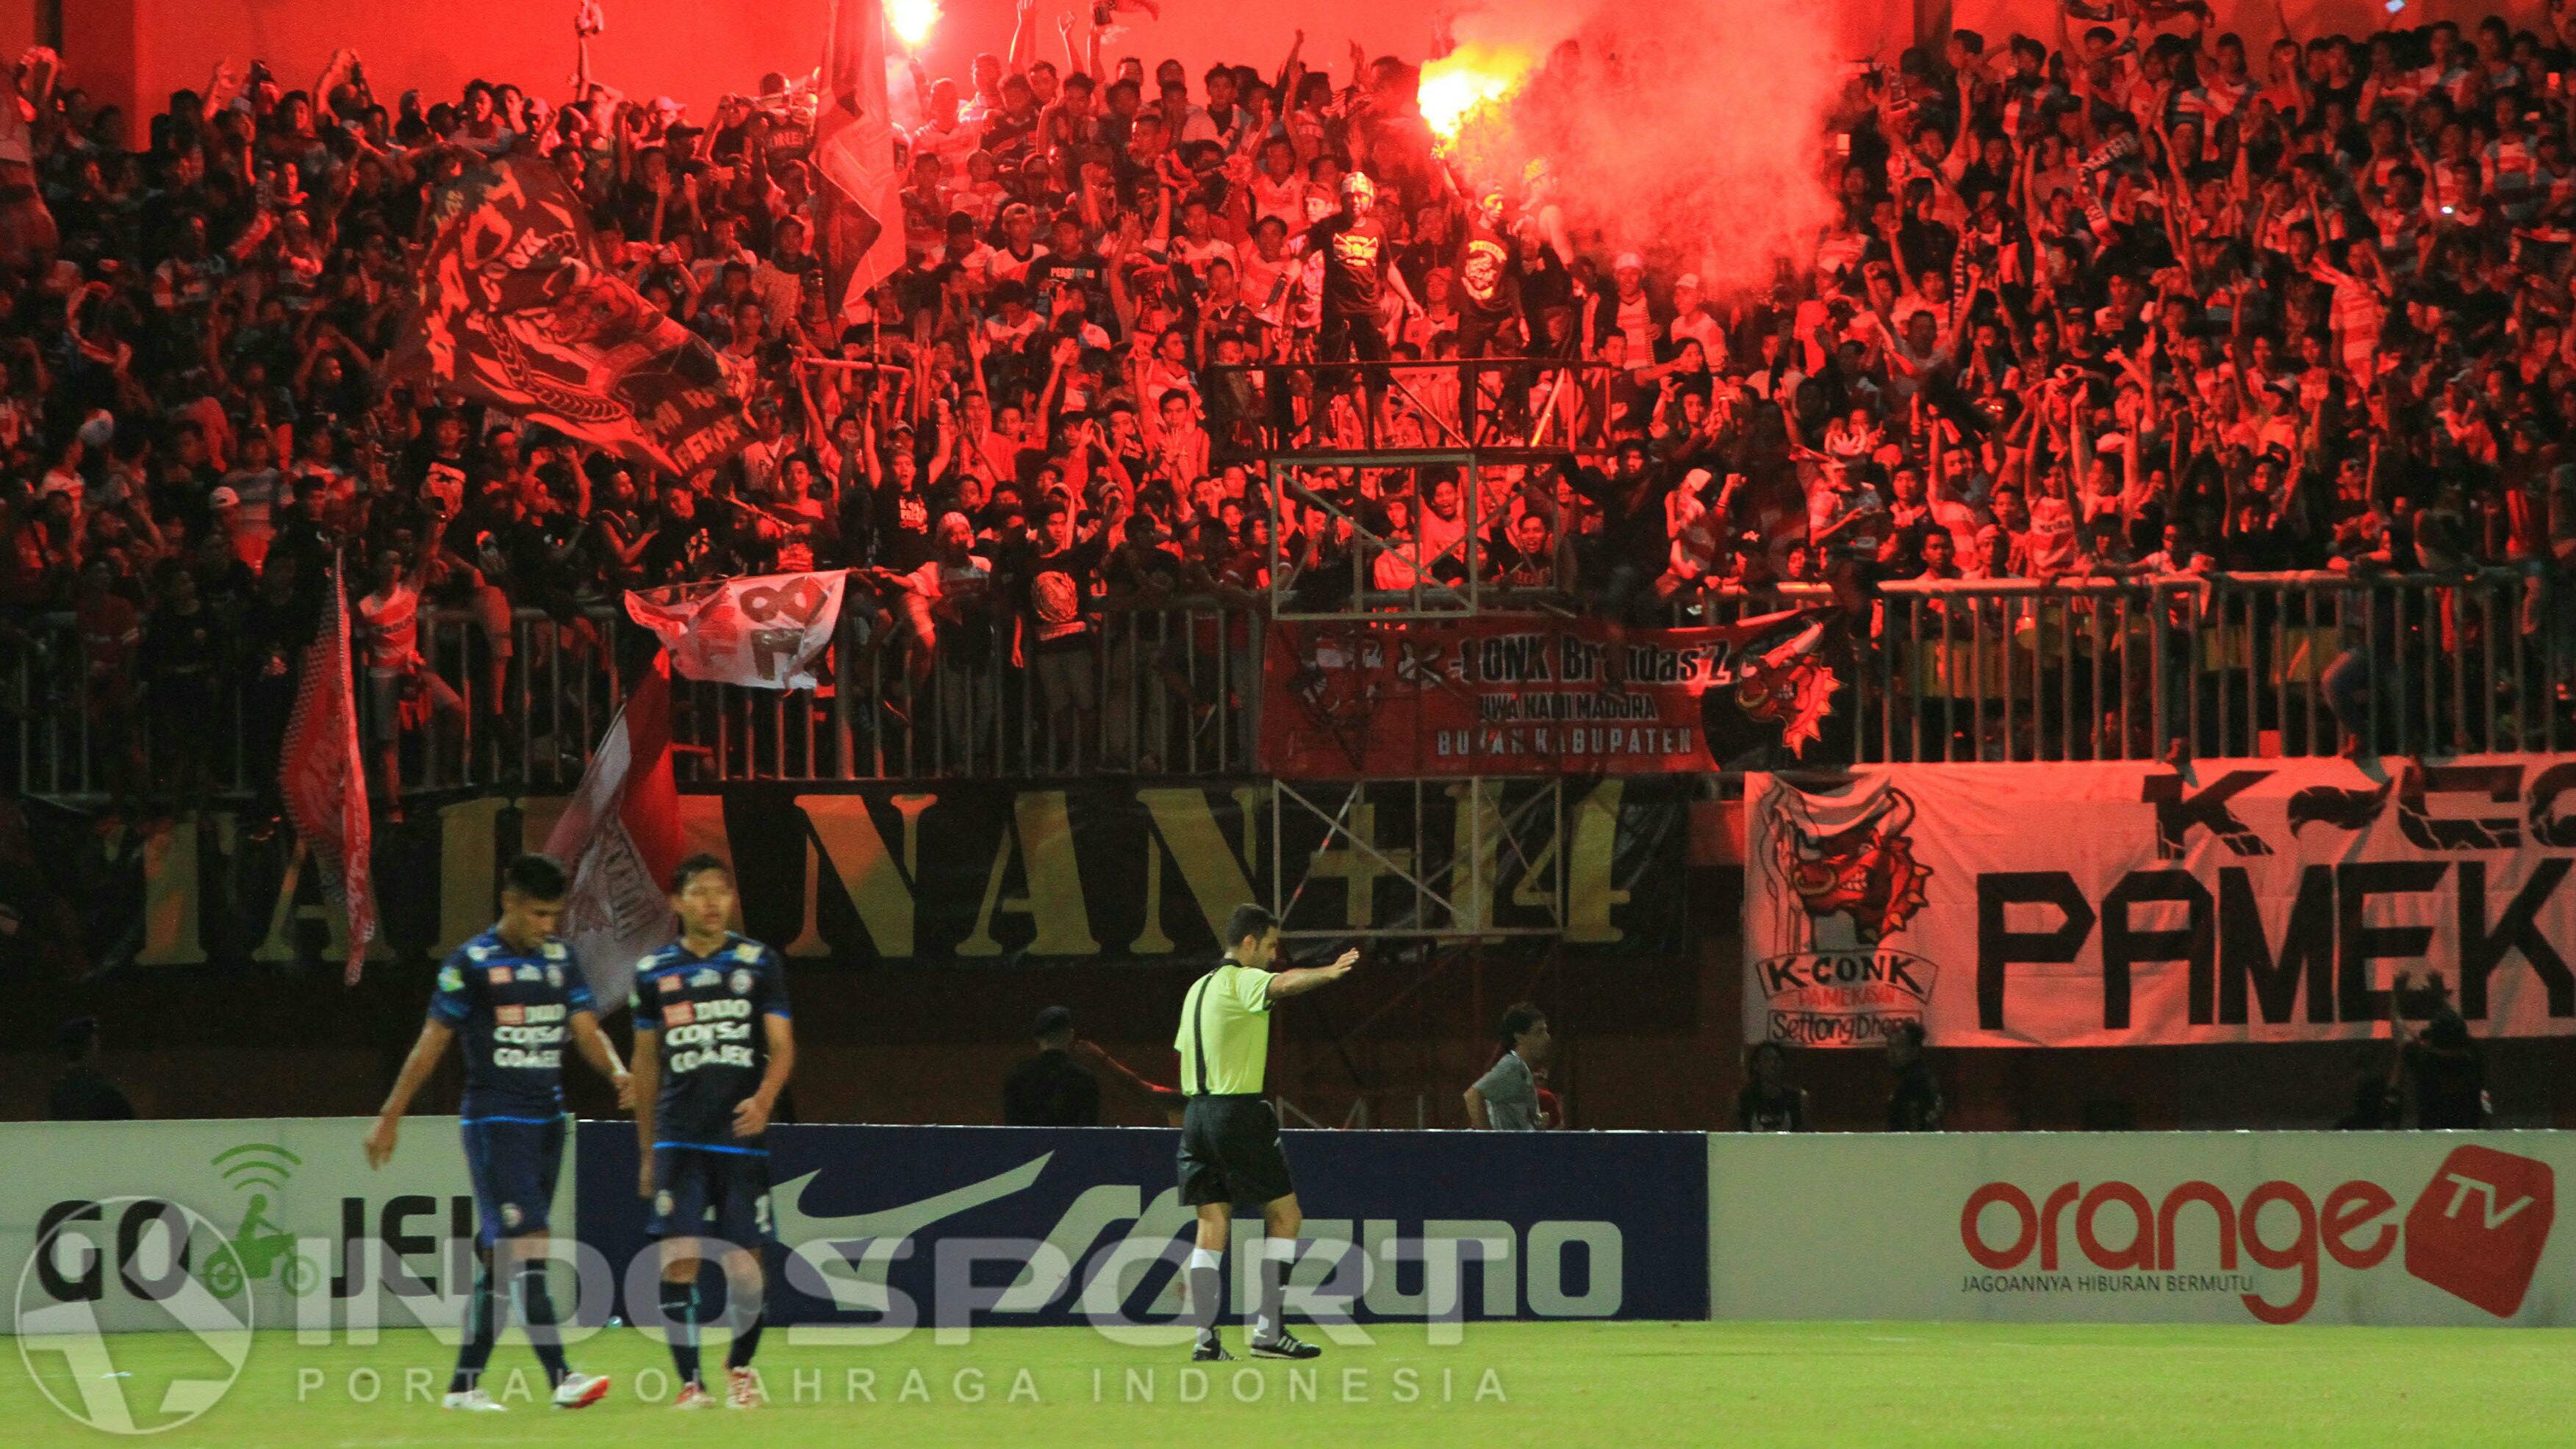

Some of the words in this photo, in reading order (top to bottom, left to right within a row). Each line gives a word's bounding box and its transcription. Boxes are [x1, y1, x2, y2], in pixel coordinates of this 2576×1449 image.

[1767, 955, 1924, 993] K-CONK
[36, 1199, 191, 1303] GO
[1961, 1180, 2398, 1323] orange
[2443, 1172, 2535, 1230] TV
[1962, 1275, 2072, 1293] JAGOANNYA
[2078, 1275, 2161, 1292] HIBURAN
[2166, 1275, 2255, 1292] BERMUTU
